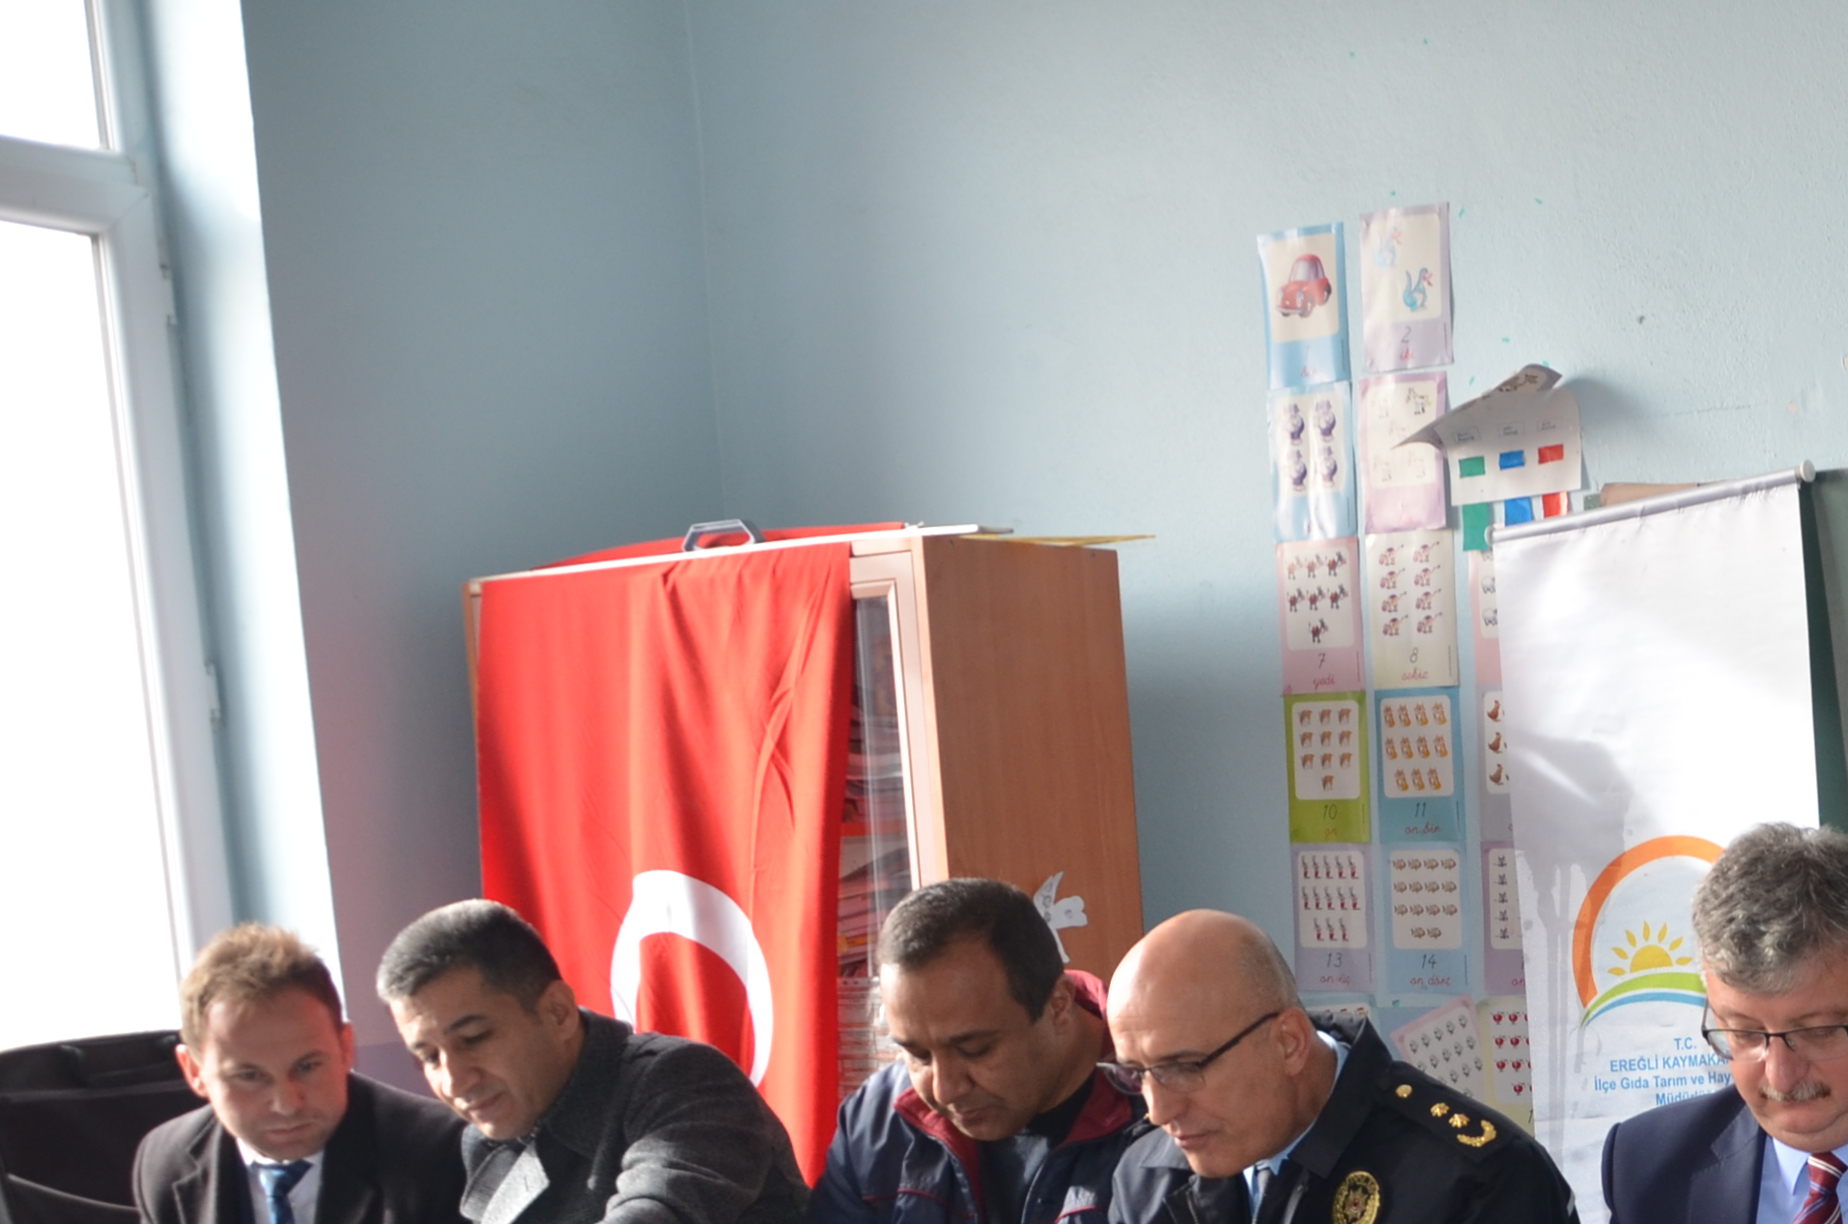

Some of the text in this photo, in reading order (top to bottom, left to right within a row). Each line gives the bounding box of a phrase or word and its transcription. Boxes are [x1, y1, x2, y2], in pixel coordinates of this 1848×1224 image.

[1318, 653, 1326, 669] 7
[1410, 647, 1419, 663] 8
[1323, 804, 1337, 820] 10
[1415, 802, 1427, 817] 11
[1326, 952, 1342, 968] 13
[1421, 953, 1437, 969] 14
[1673, 1037, 1697, 1051] T.C.
[1610, 1055, 1658, 1072] EREĞLİ
[1594, 1075, 1617, 1093] İlçe
[1620, 1077, 1650, 1090] Gıda
[1653, 1074, 1687, 1088] Tarım
[1691, 1075, 1704, 1085] ve
